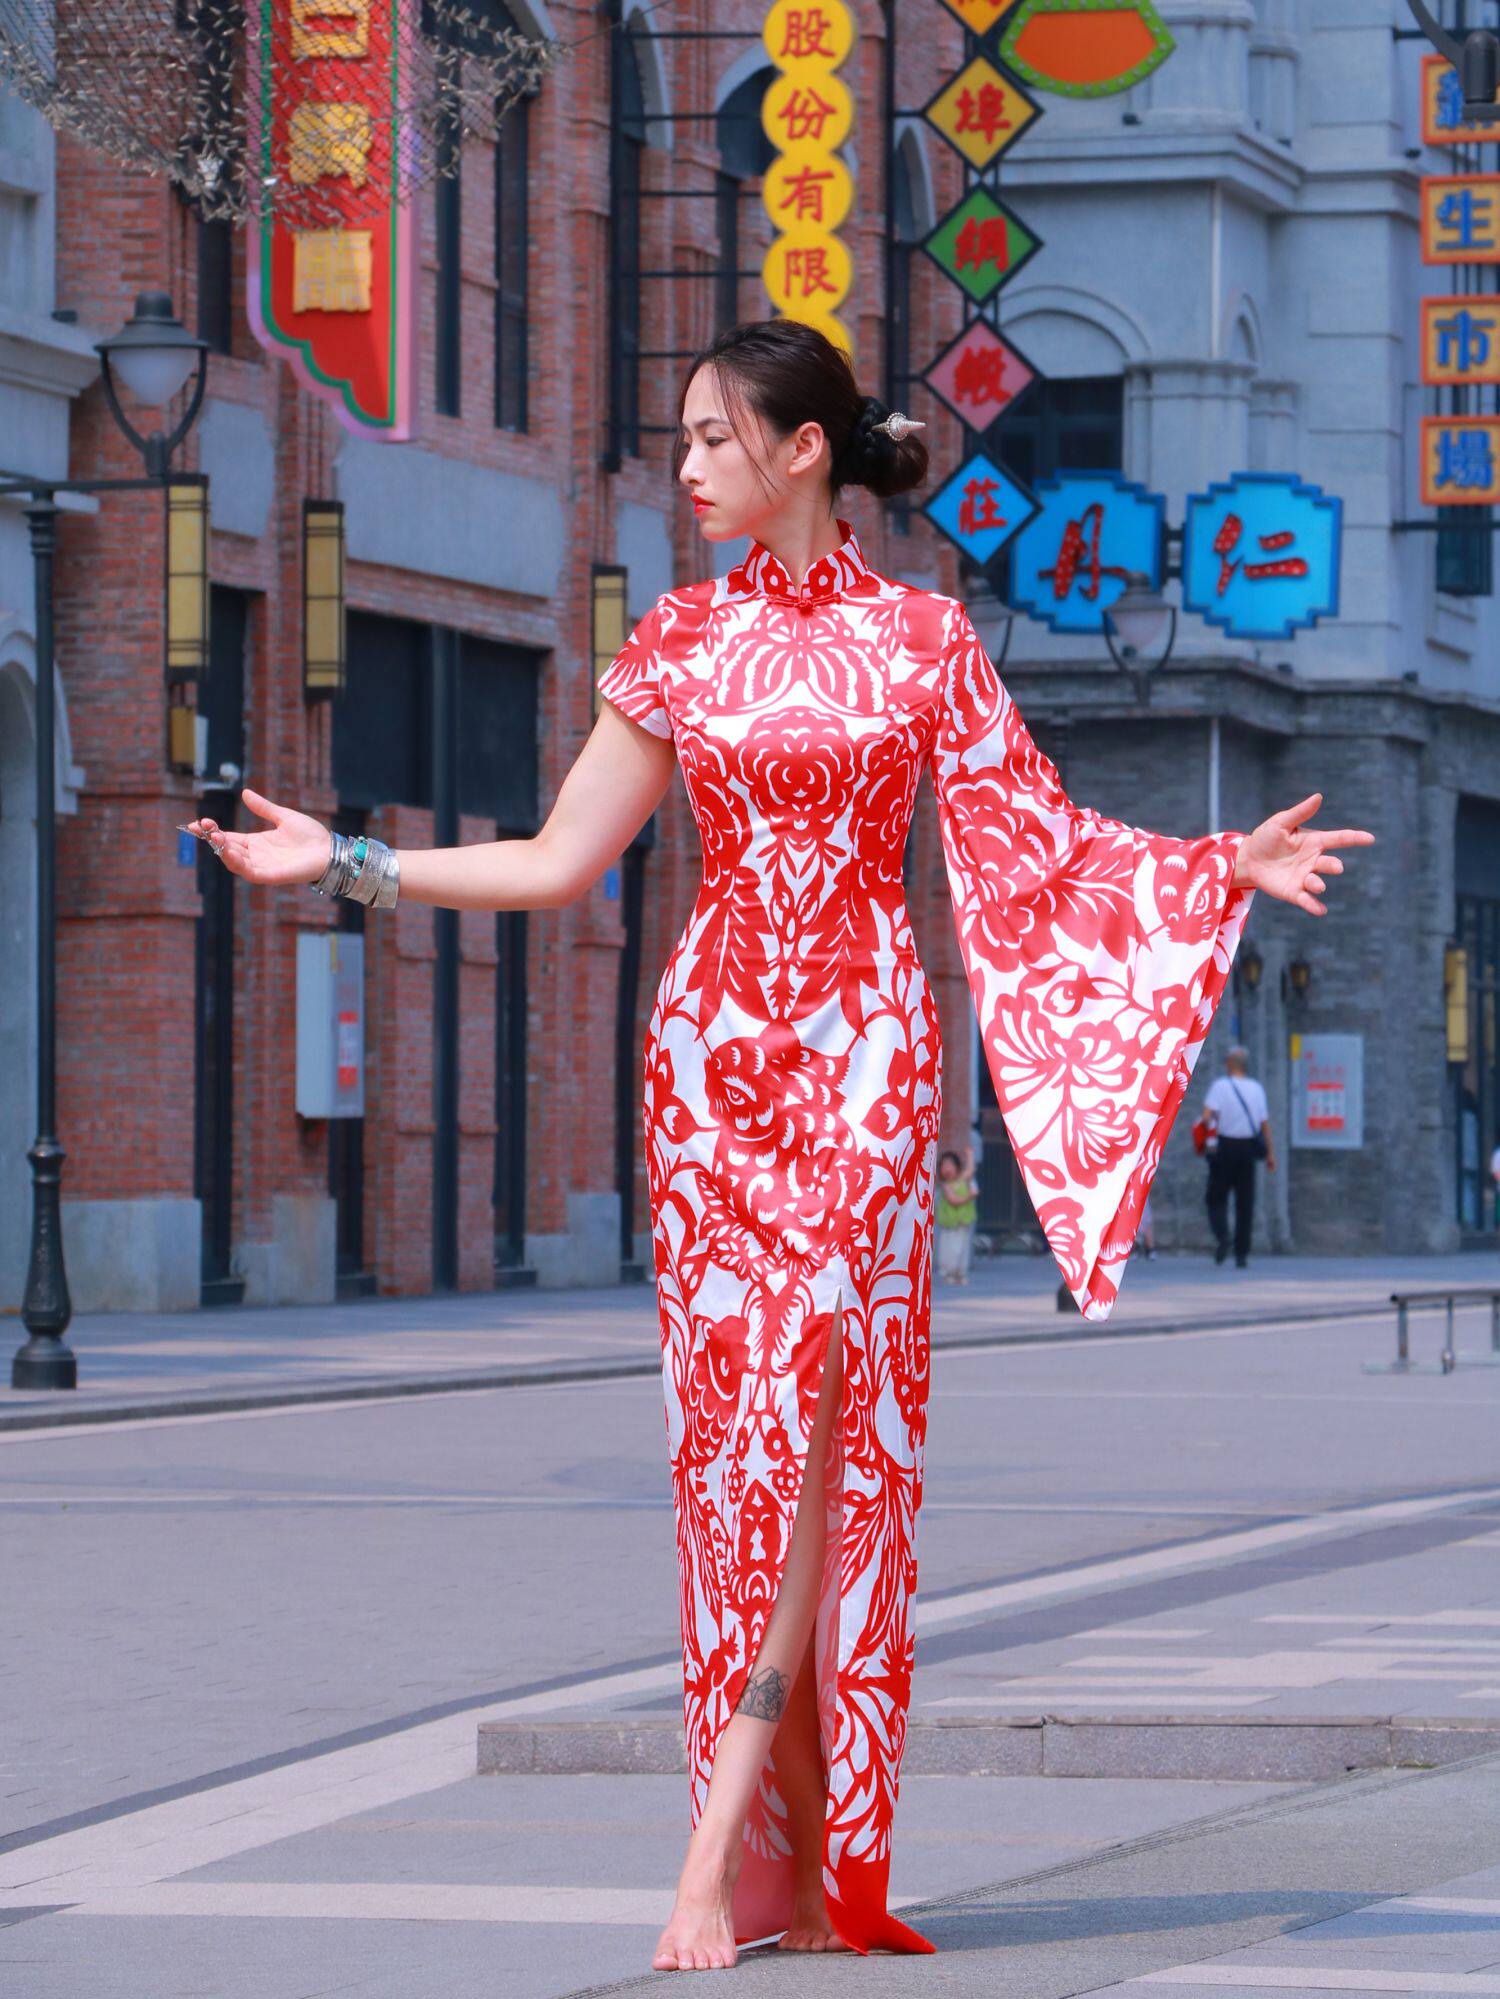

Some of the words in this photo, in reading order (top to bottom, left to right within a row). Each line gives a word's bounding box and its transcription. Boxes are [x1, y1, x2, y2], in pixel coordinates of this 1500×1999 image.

[777, 8, 839, 299] 股份有限
[953, 0, 1013, 535] 埠綢緞莊
